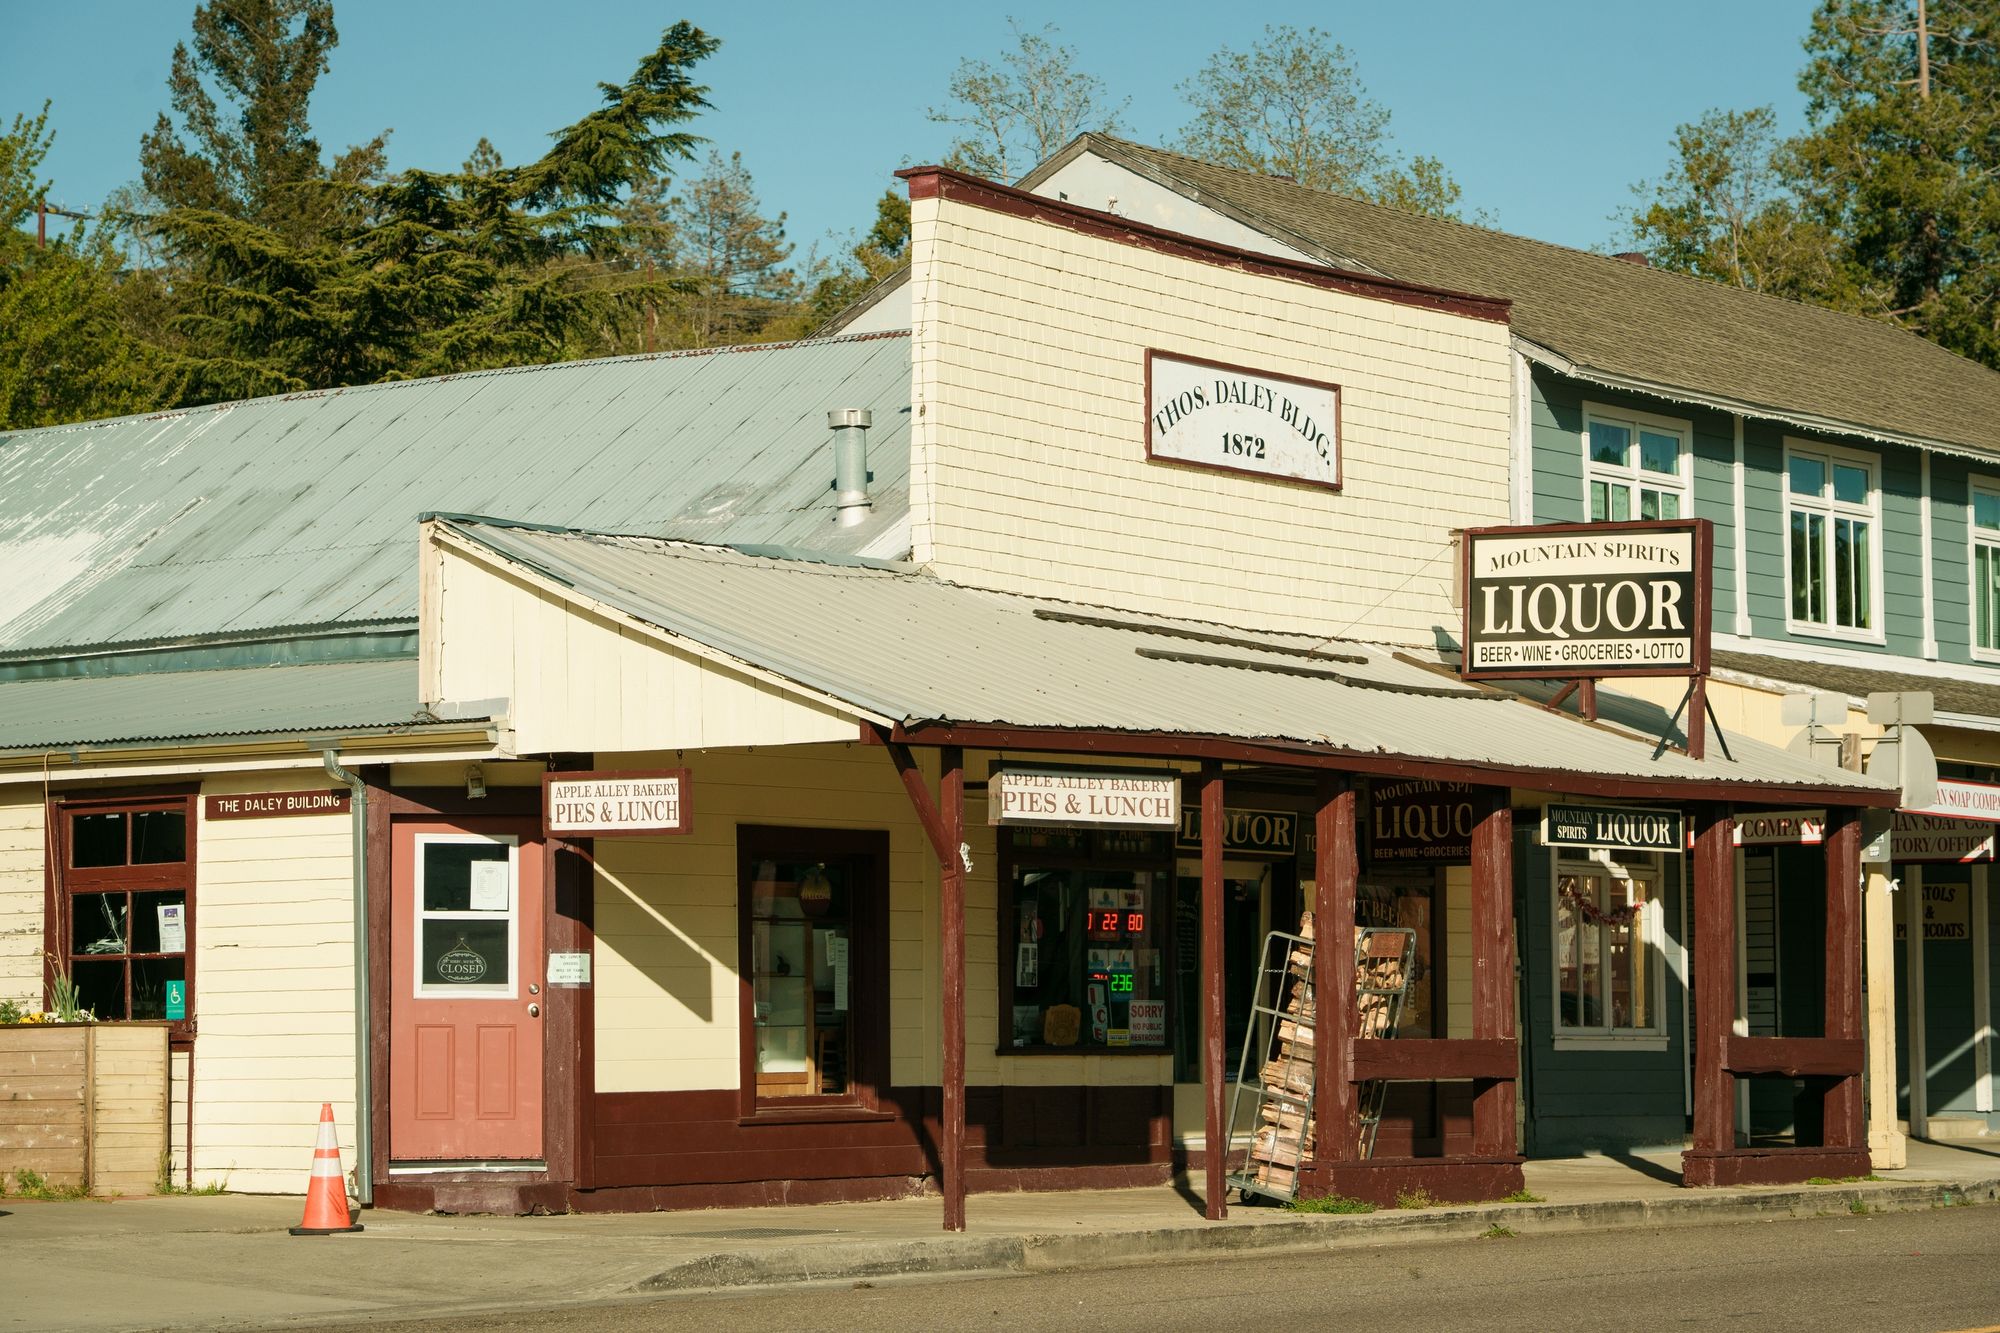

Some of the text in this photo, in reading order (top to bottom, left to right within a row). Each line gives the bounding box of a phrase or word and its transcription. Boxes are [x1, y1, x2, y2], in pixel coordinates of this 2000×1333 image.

[1152, 380, 1331, 466] THOS. DALEY BLDG.
[1222, 432, 1265, 459] 1872
[1490, 542, 1680, 572] MOUNTAIN SPIRITS
[1480, 580, 1685, 639] LIQUOR
[1480, 642, 1684, 662] BEER WINE GROCERIES LOTTO
[555, 783, 678, 798] APPLE ALLEY BAKERY
[1001, 774, 1170, 793] APPLE ALLEY BAKERY
[1447, 781, 1473, 794] SPI
[218, 795, 340, 813] THE DALEY BUILDING
[1001, 791, 1171, 818] PIES & LUNCH
[1973, 791, 2000, 811] COMP
[555, 800, 678, 823] PIES & LUNCH
[1182, 811, 1290, 846] LUOR
[1375, 803, 1473, 842] LIQUO
[1551, 809, 1593, 840] MOUNTAIN SPIRITS
[1596, 812, 1672, 845] LIQUOR
[1742, 816, 1825, 838] COMPANY
[1423, 846, 1470, 857] GROCERIES
[1891, 836, 1990, 854] TORY/OFFICE
[1921, 886, 1956, 902] TOLS
[1925, 905, 1935, 919] &
[1896, 922, 1965, 938] PICOATS
[440, 964, 484, 974] CLOSED
[1111, 974, 1133, 991] 236
[1130, 1005, 1164, 1018] SORRY
